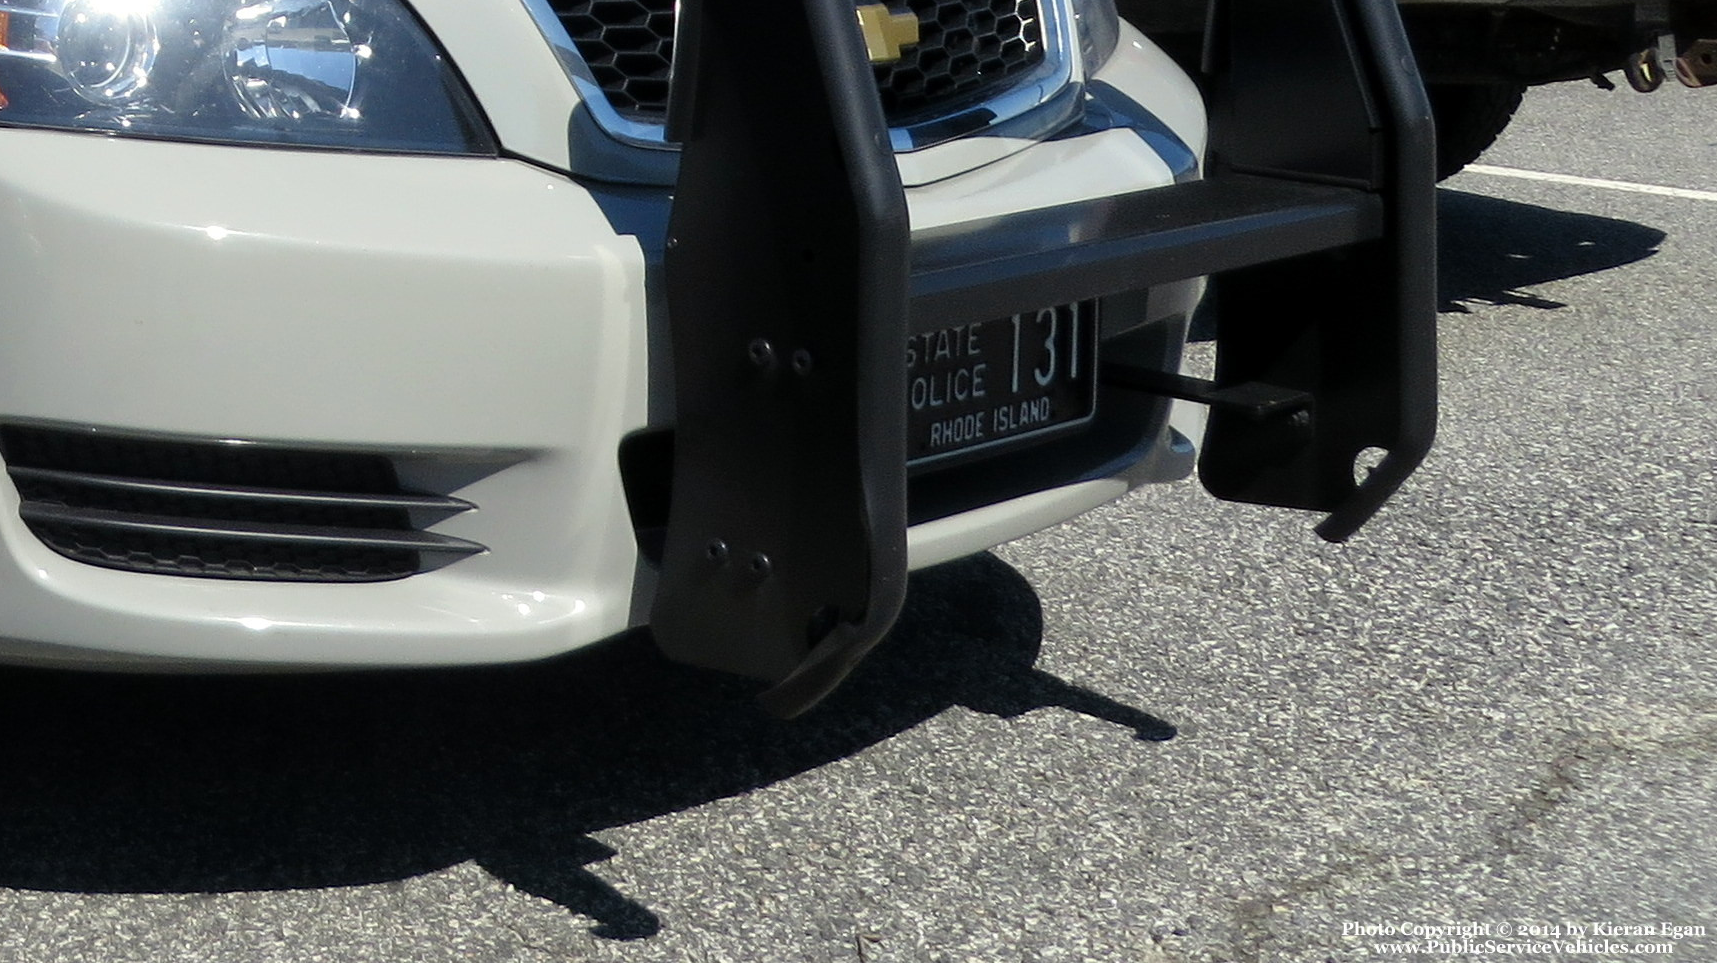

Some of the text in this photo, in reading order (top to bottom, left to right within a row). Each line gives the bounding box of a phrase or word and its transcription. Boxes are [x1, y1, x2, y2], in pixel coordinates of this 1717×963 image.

[1012, 303, 1078, 393] 131
[912, 364, 987, 409] OLICE
[930, 397, 1050, 447] RHODE ISLAND
